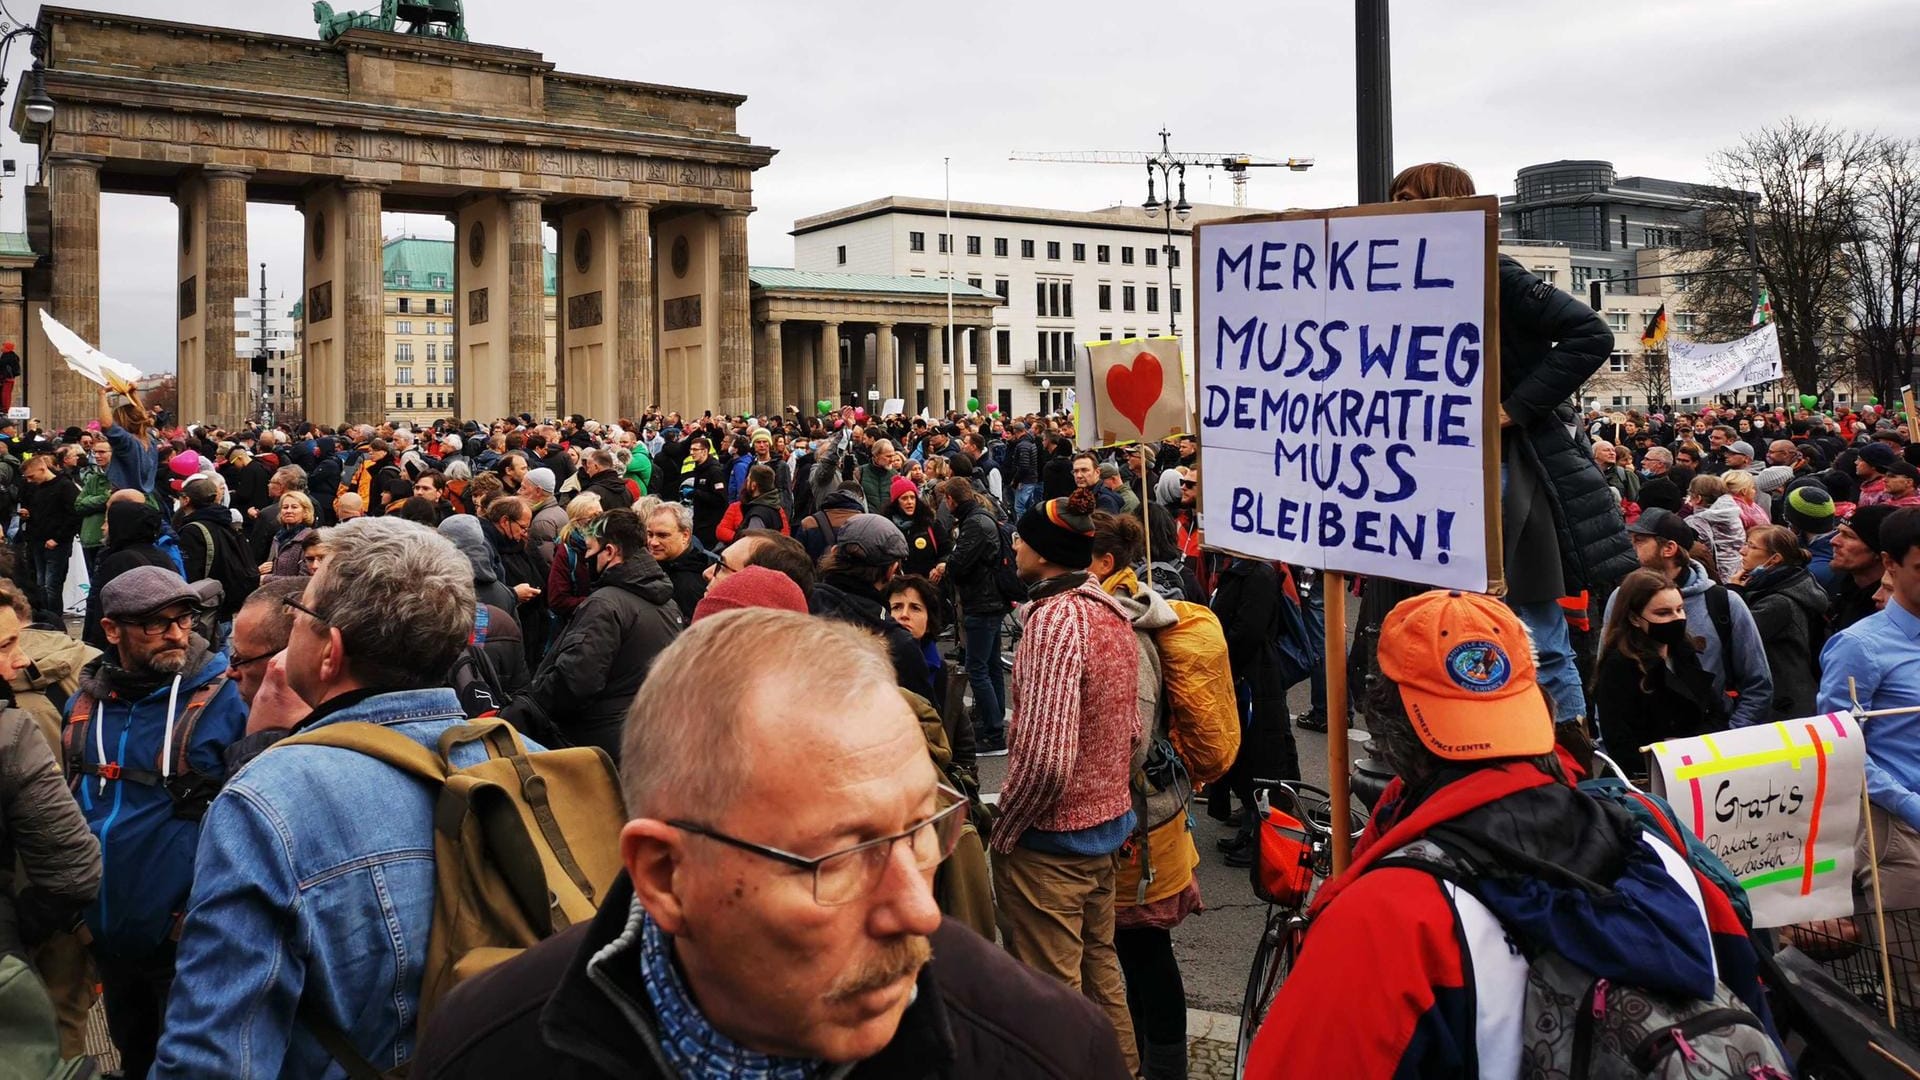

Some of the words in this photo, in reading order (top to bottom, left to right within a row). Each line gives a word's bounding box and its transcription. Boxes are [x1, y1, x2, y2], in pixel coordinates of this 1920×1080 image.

[1216, 238, 1455, 292] MERKEL
[1216, 315, 1350, 381] MUSS
[1359, 322, 1480, 387] WEG
[1203, 385, 1475, 447] DEMOKRATIE
[1274, 438, 1418, 503] MUSS
[1230, 487, 1456, 565] BLEIBEN!
[1430, 737, 1453, 752] SPACE
[1455, 743, 1492, 752] CENTER
[1714, 778, 1804, 829] Gratis
